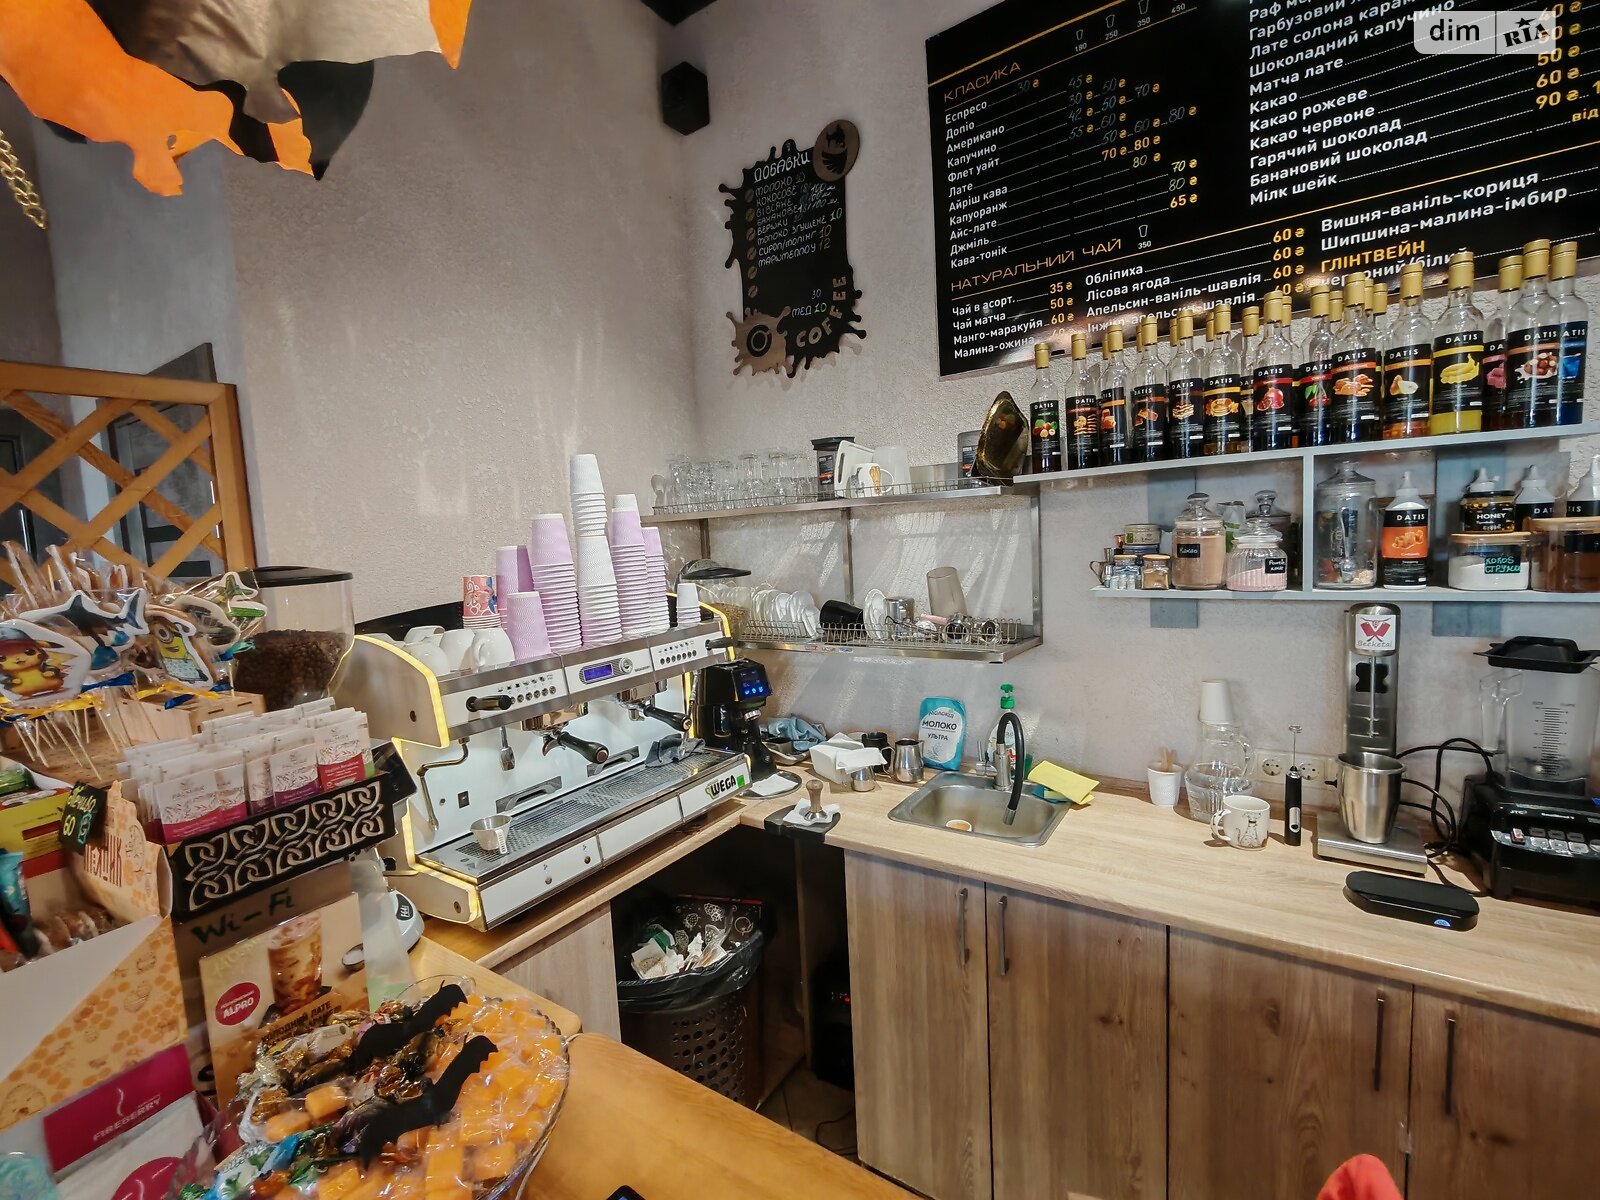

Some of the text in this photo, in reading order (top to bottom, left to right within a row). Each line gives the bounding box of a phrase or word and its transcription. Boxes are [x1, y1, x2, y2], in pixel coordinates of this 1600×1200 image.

[1137, 17, 1151, 28] 350
[1249, 2, 1281, 22] Раф
[1249, 0, 1345, 41] Гарбузовий
[1249, 15, 1354, 60] Лате солона
[1249, 1, 1455, 78] Шоколадний капучино
[944, 62, 1021, 102] КЛАСИКА
[1249, 58, 1344, 97] Матча лате
[945, 101, 988, 125] Еспресо
[1249, 47, 1562, 151] Какао червоне 50
[1249, 92, 1298, 115] Какао
[1249, 111, 1298, 133] Какао
[1302, 89, 1368, 120] рожеве
[945, 121, 975, 141] Допіо
[1249, 69, 1562, 169] Гарячий шоколад 60
[946, 125, 1005, 154] Американо
[1250, 152, 1341, 187] Банановий
[1346, 131, 1428, 162] шоколад
[1535, 91, 1562, 110] 90
[754, 151, 811, 183] ДОБАВКИ
[947, 144, 997, 169] Капучино
[947, 167, 974, 182] Флет
[976, 158, 1000, 175] уайт
[948, 195, 980, 213] Айріш
[983, 186, 1008, 201] кава
[1101, 147, 1117, 161] 70
[1134, 137, 1150, 151] 80
[948, 183, 974, 198] Лате
[949, 201, 1008, 226] Капуоранж
[1132, 155, 1148, 168] 80
[1250, 186, 1288, 206] Мілк
[1292, 173, 1338, 195] шейк
[949, 219, 998, 241] Айс-лате
[1171, 160, 1186, 173] 70
[1321, 172, 1539, 233] Вишня-ваніль-кориця
[949, 238, 990, 257] Джміль
[1168, 177, 1186, 192] 80
[950, 245, 1008, 269] Кава-тонік
[1170, 194, 1187, 209] 65
[1321, 187, 1568, 251] Шипшина-малина-імбир
[951, 238, 1152, 292] НАТУРАЛЬНИЙ ЧАЙ 350
[1085, 265, 1143, 286] Обліпиха
[1272, 228, 1292, 243] 60
[1321, 239, 1425, 274] ГЛІНТВЕЙН
[1086, 285, 1129, 302] Лісова
[1131, 276, 1171, 292] ягода
[1272, 246, 1292, 261] 60
[952, 304, 972, 317] Чай
[974, 303, 980, 312] в
[982, 295, 1016, 311] асорт.
[1049, 283, 1064, 294] 35
[1086, 273, 1262, 318] Апельсин-ваніль-шавлія
[1272, 265, 1292, 280] 60
[796, 276, 847, 348] COFFEE
[952, 319, 972, 331] Чай
[974, 312, 1006, 328] матча
[1049, 297, 1064, 309] 50
[953, 318, 1043, 345] Манго-маракуйя
[1050, 313, 1065, 325] 60
[1445, 333, 1479, 344] DATIS
[1524, 330, 1558, 341] DATIS
[1562, 328, 1586, 338] ATIS
[954, 335, 1035, 360] Малина-ожина
[1337, 351, 1367, 362] DATIS
[1389, 348, 1419, 360] DATIS
[1171, 381, 1194, 390] DATIS
[1209, 377, 1233, 386] DATIS
[1258, 367, 1284, 377] DATIS
[1034, 402, 1054, 410] DATIS
[921, 720, 957, 731] МОЛОКО
[927, 732, 949, 741] УЛЬТРА
[710, 774, 737, 797] WEGA
[223, 996, 255, 1019] ALPRO
